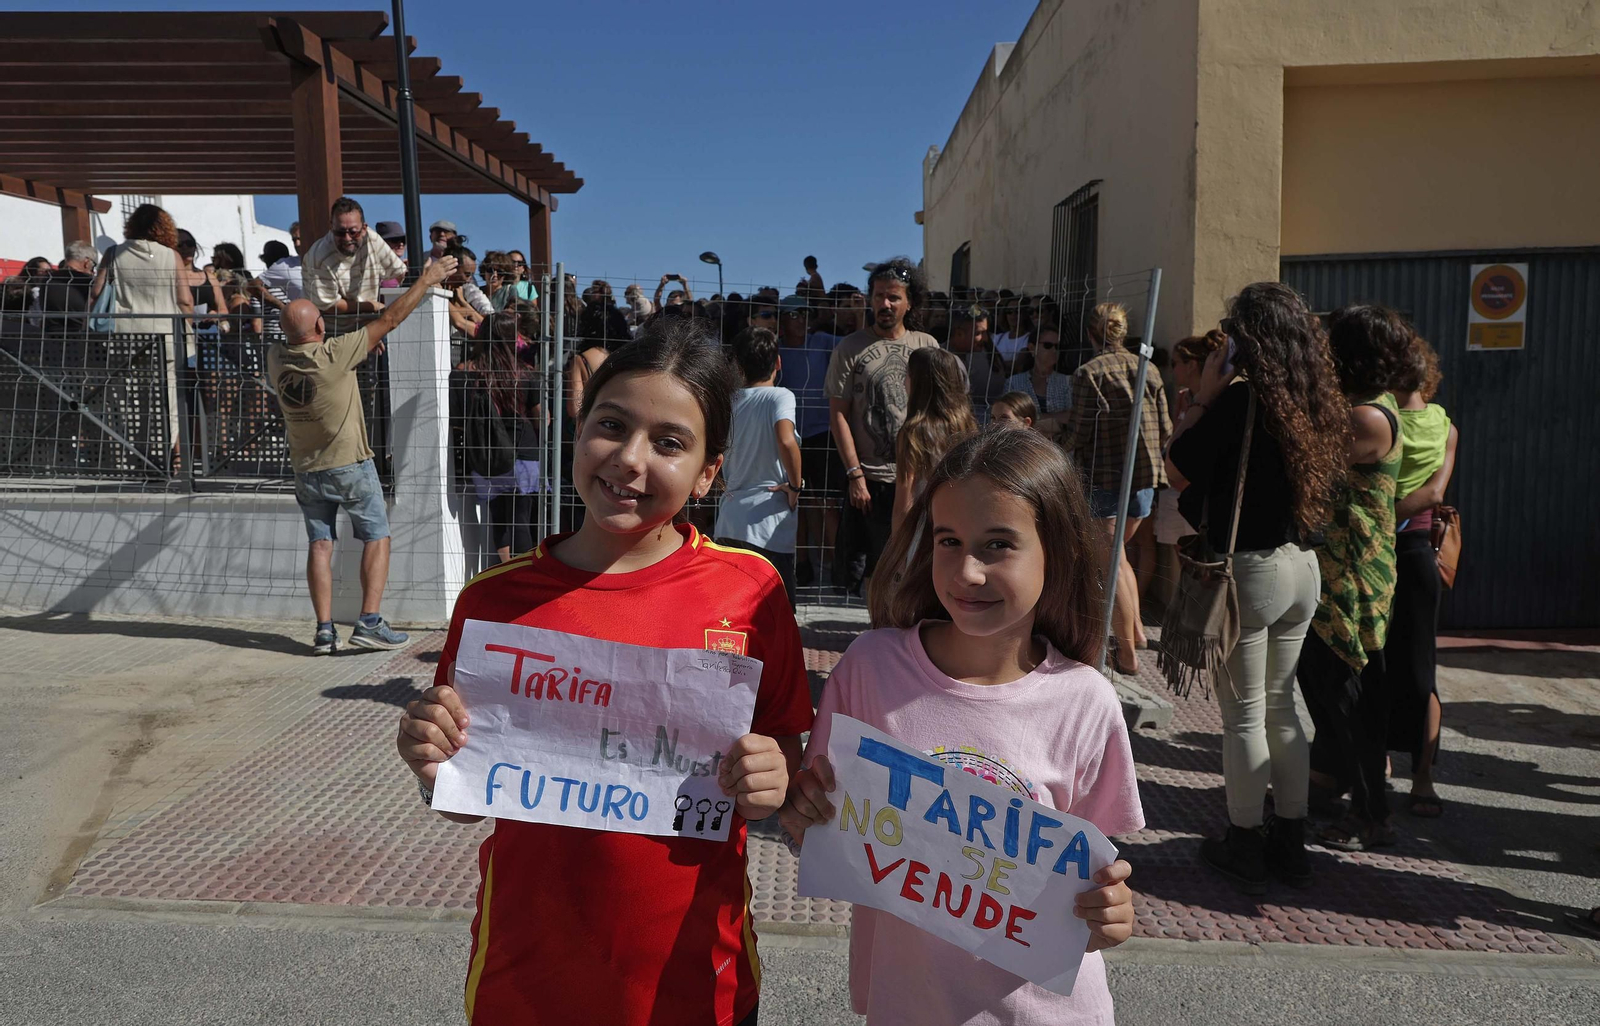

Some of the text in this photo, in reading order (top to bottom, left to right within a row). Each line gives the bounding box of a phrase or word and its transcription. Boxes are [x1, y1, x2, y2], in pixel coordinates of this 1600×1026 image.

[484, 643, 612, 708] TARiFA
[485, 762, 649, 821] FUTURO
[600, 725, 724, 778] Es Nuest
[839, 791, 1018, 895] NO SE
[857, 736, 1091, 880] TARiFA
[863, 843, 1037, 948] VENDE
